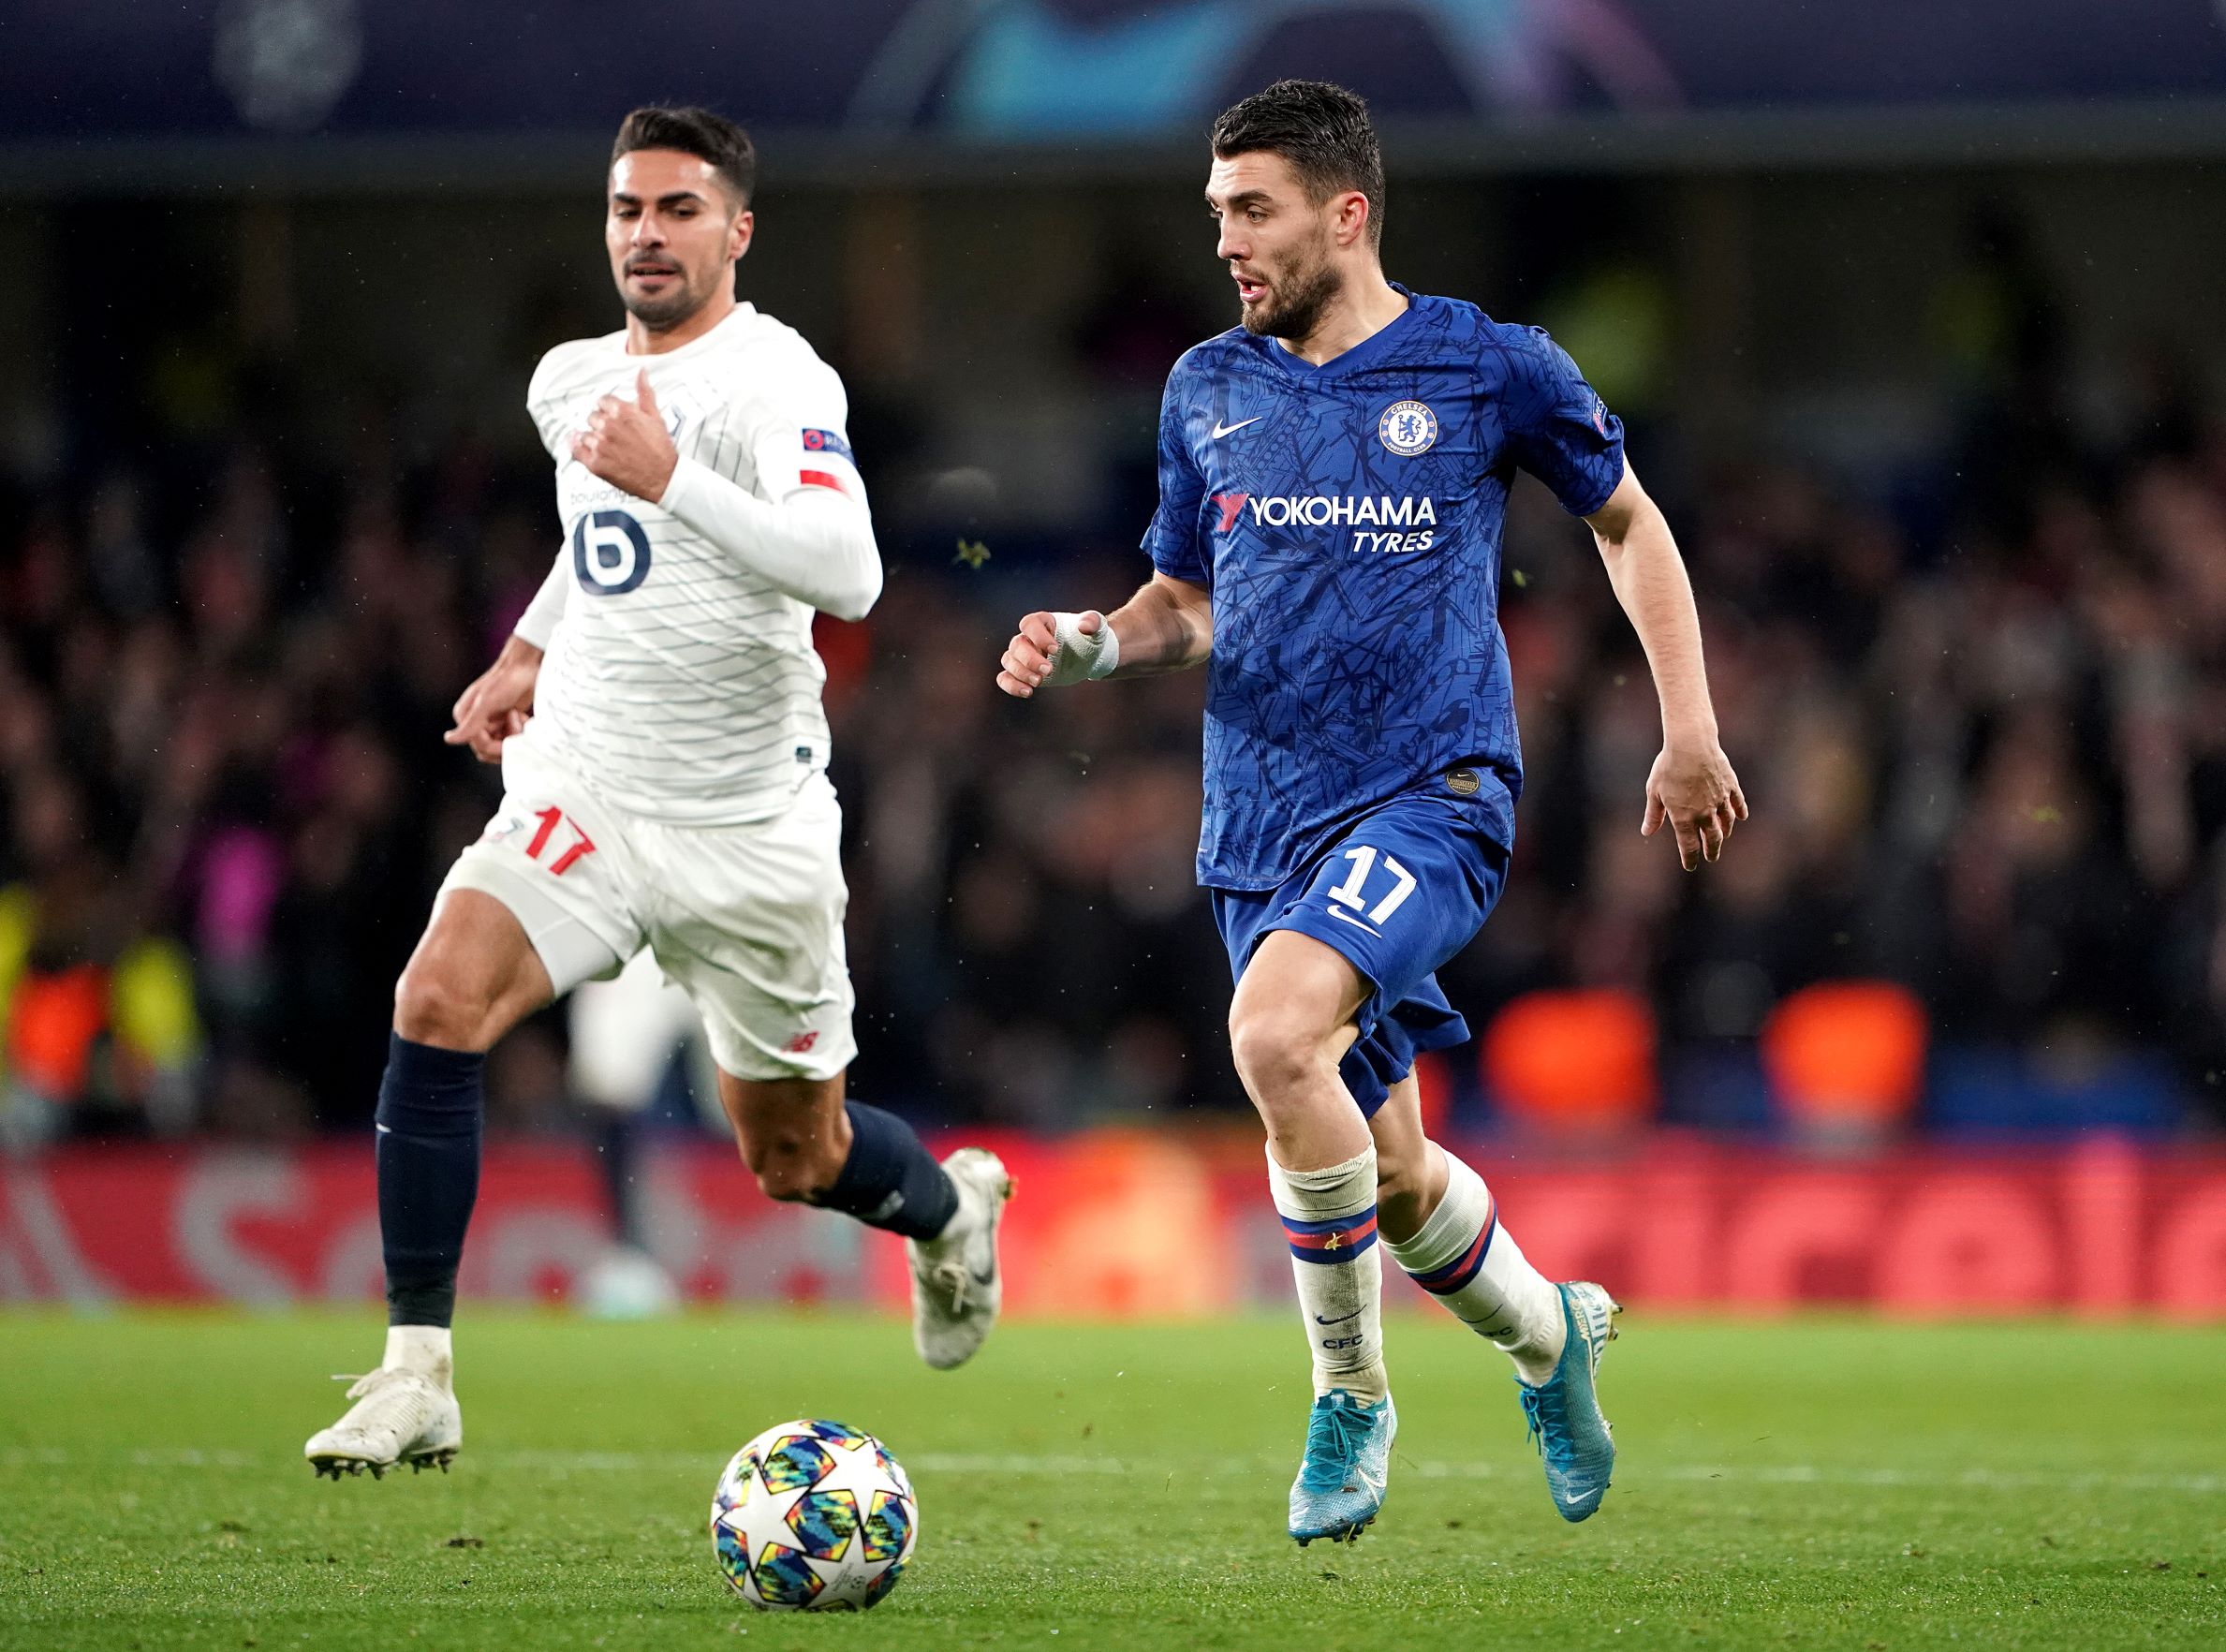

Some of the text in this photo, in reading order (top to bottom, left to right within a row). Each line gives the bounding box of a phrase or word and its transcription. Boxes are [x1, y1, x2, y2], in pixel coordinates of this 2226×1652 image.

[1391, 403, 1428, 417] CHELSEA
[1388, 442, 1426, 453] FOOTBALL CLUB
[1248, 495, 1437, 526] YOKOHAMA
[1352, 530, 1434, 553] TYRES
[525, 805, 597, 877] 17
[1327, 845, 1417, 926] 17
[1322, 1335, 1364, 1350] CFC
